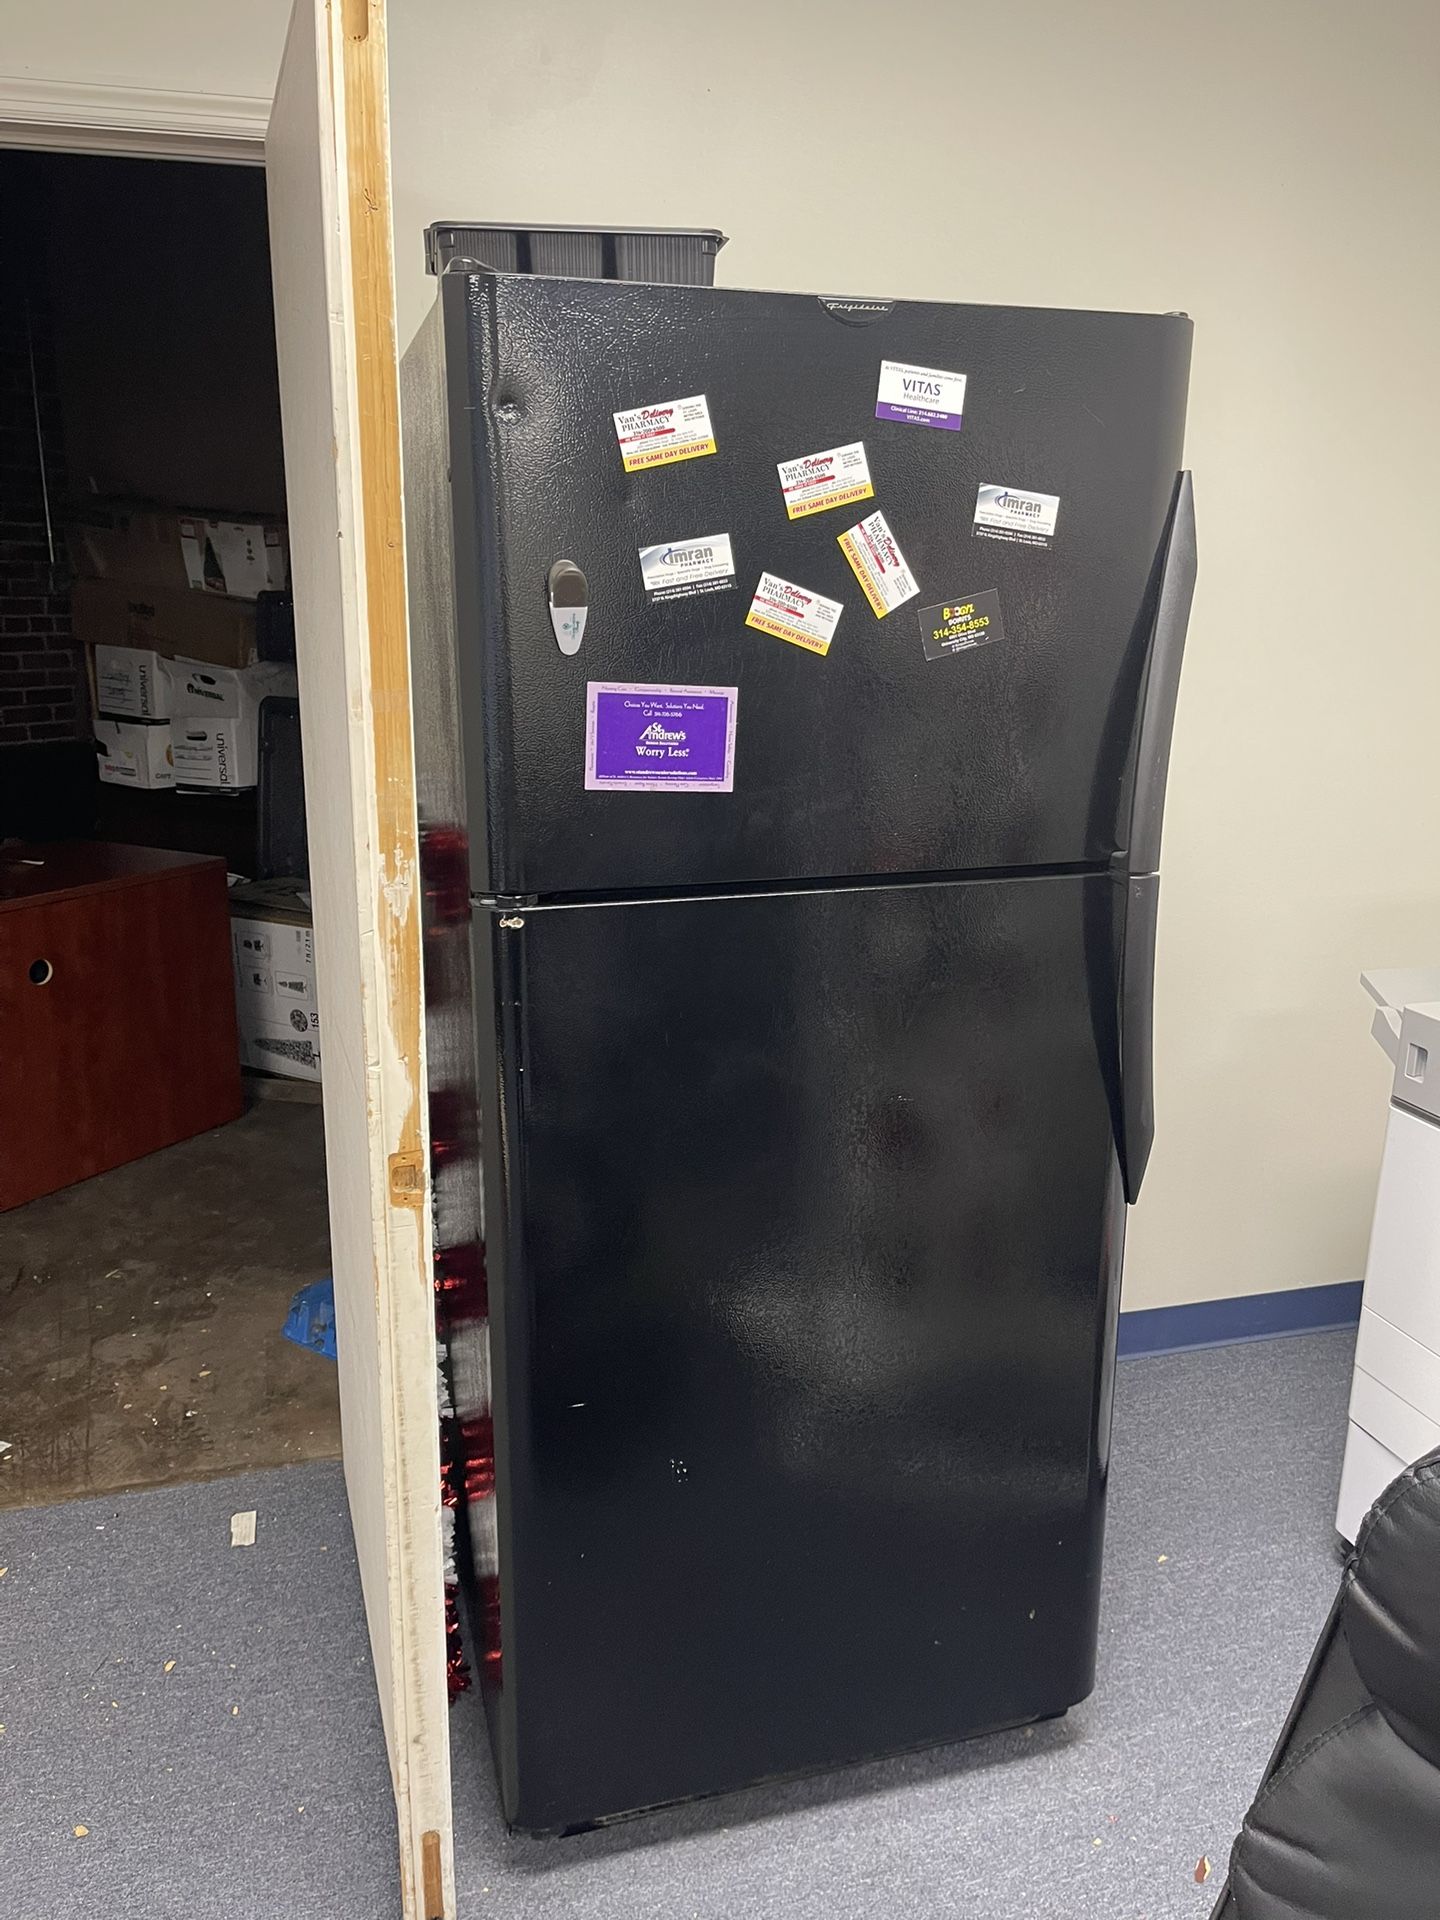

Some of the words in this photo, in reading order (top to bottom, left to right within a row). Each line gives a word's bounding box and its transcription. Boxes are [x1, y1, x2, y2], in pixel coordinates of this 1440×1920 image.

[827, 303, 888, 312] Frigidaire
[902, 378, 941, 396] VITAS
[903, 392, 940, 405] Healthcare
[618, 413, 641, 424] Van's
[641, 408, 674, 420] Delivery
[622, 416, 670, 432] PHARMACY
[629, 456, 645, 466] FREE
[646, 453, 663, 463] SAME
[664, 450, 677, 458] DAY
[679, 443, 709, 455] DELIVERY
[782, 463, 804, 474] Van's
[803, 457, 834, 469] Delivery
[785, 464, 830, 481] PHARMACY
[792, 505, 806, 514] FREE
[808, 500, 825, 509] SAME
[825, 496, 838, 504] DAY
[839, 488, 867, 501] DELIVERY
[1010, 509, 1040, 518] PHARMACY
[868, 522, 892, 566] PHARMACY
[680, 558, 714, 568] PHARMACY
[704, 569, 728, 577] Delivery
[844, 538, 853, 553] FREE
[851, 553, 861, 569] SAME
[859, 569, 869, 581] DAY
[867, 581, 882, 610] DELIVERY
[764, 578, 783, 591] Van's
[763, 586, 805, 608] PHARMACY
[752, 617, 765, 626] FREE
[766, 622, 782, 633] SAME
[783, 628, 795, 638] DAY
[796, 632, 823, 649] DELIVERY
[933, 616, 989, 639] 314-354-8553
[138, 664, 151, 716] universal
[639, 725, 686, 740] Andrew's
[216, 732, 231, 785] universal
[636, 746, 665, 758] Worry
[311, 1012, 319, 1029] 153
